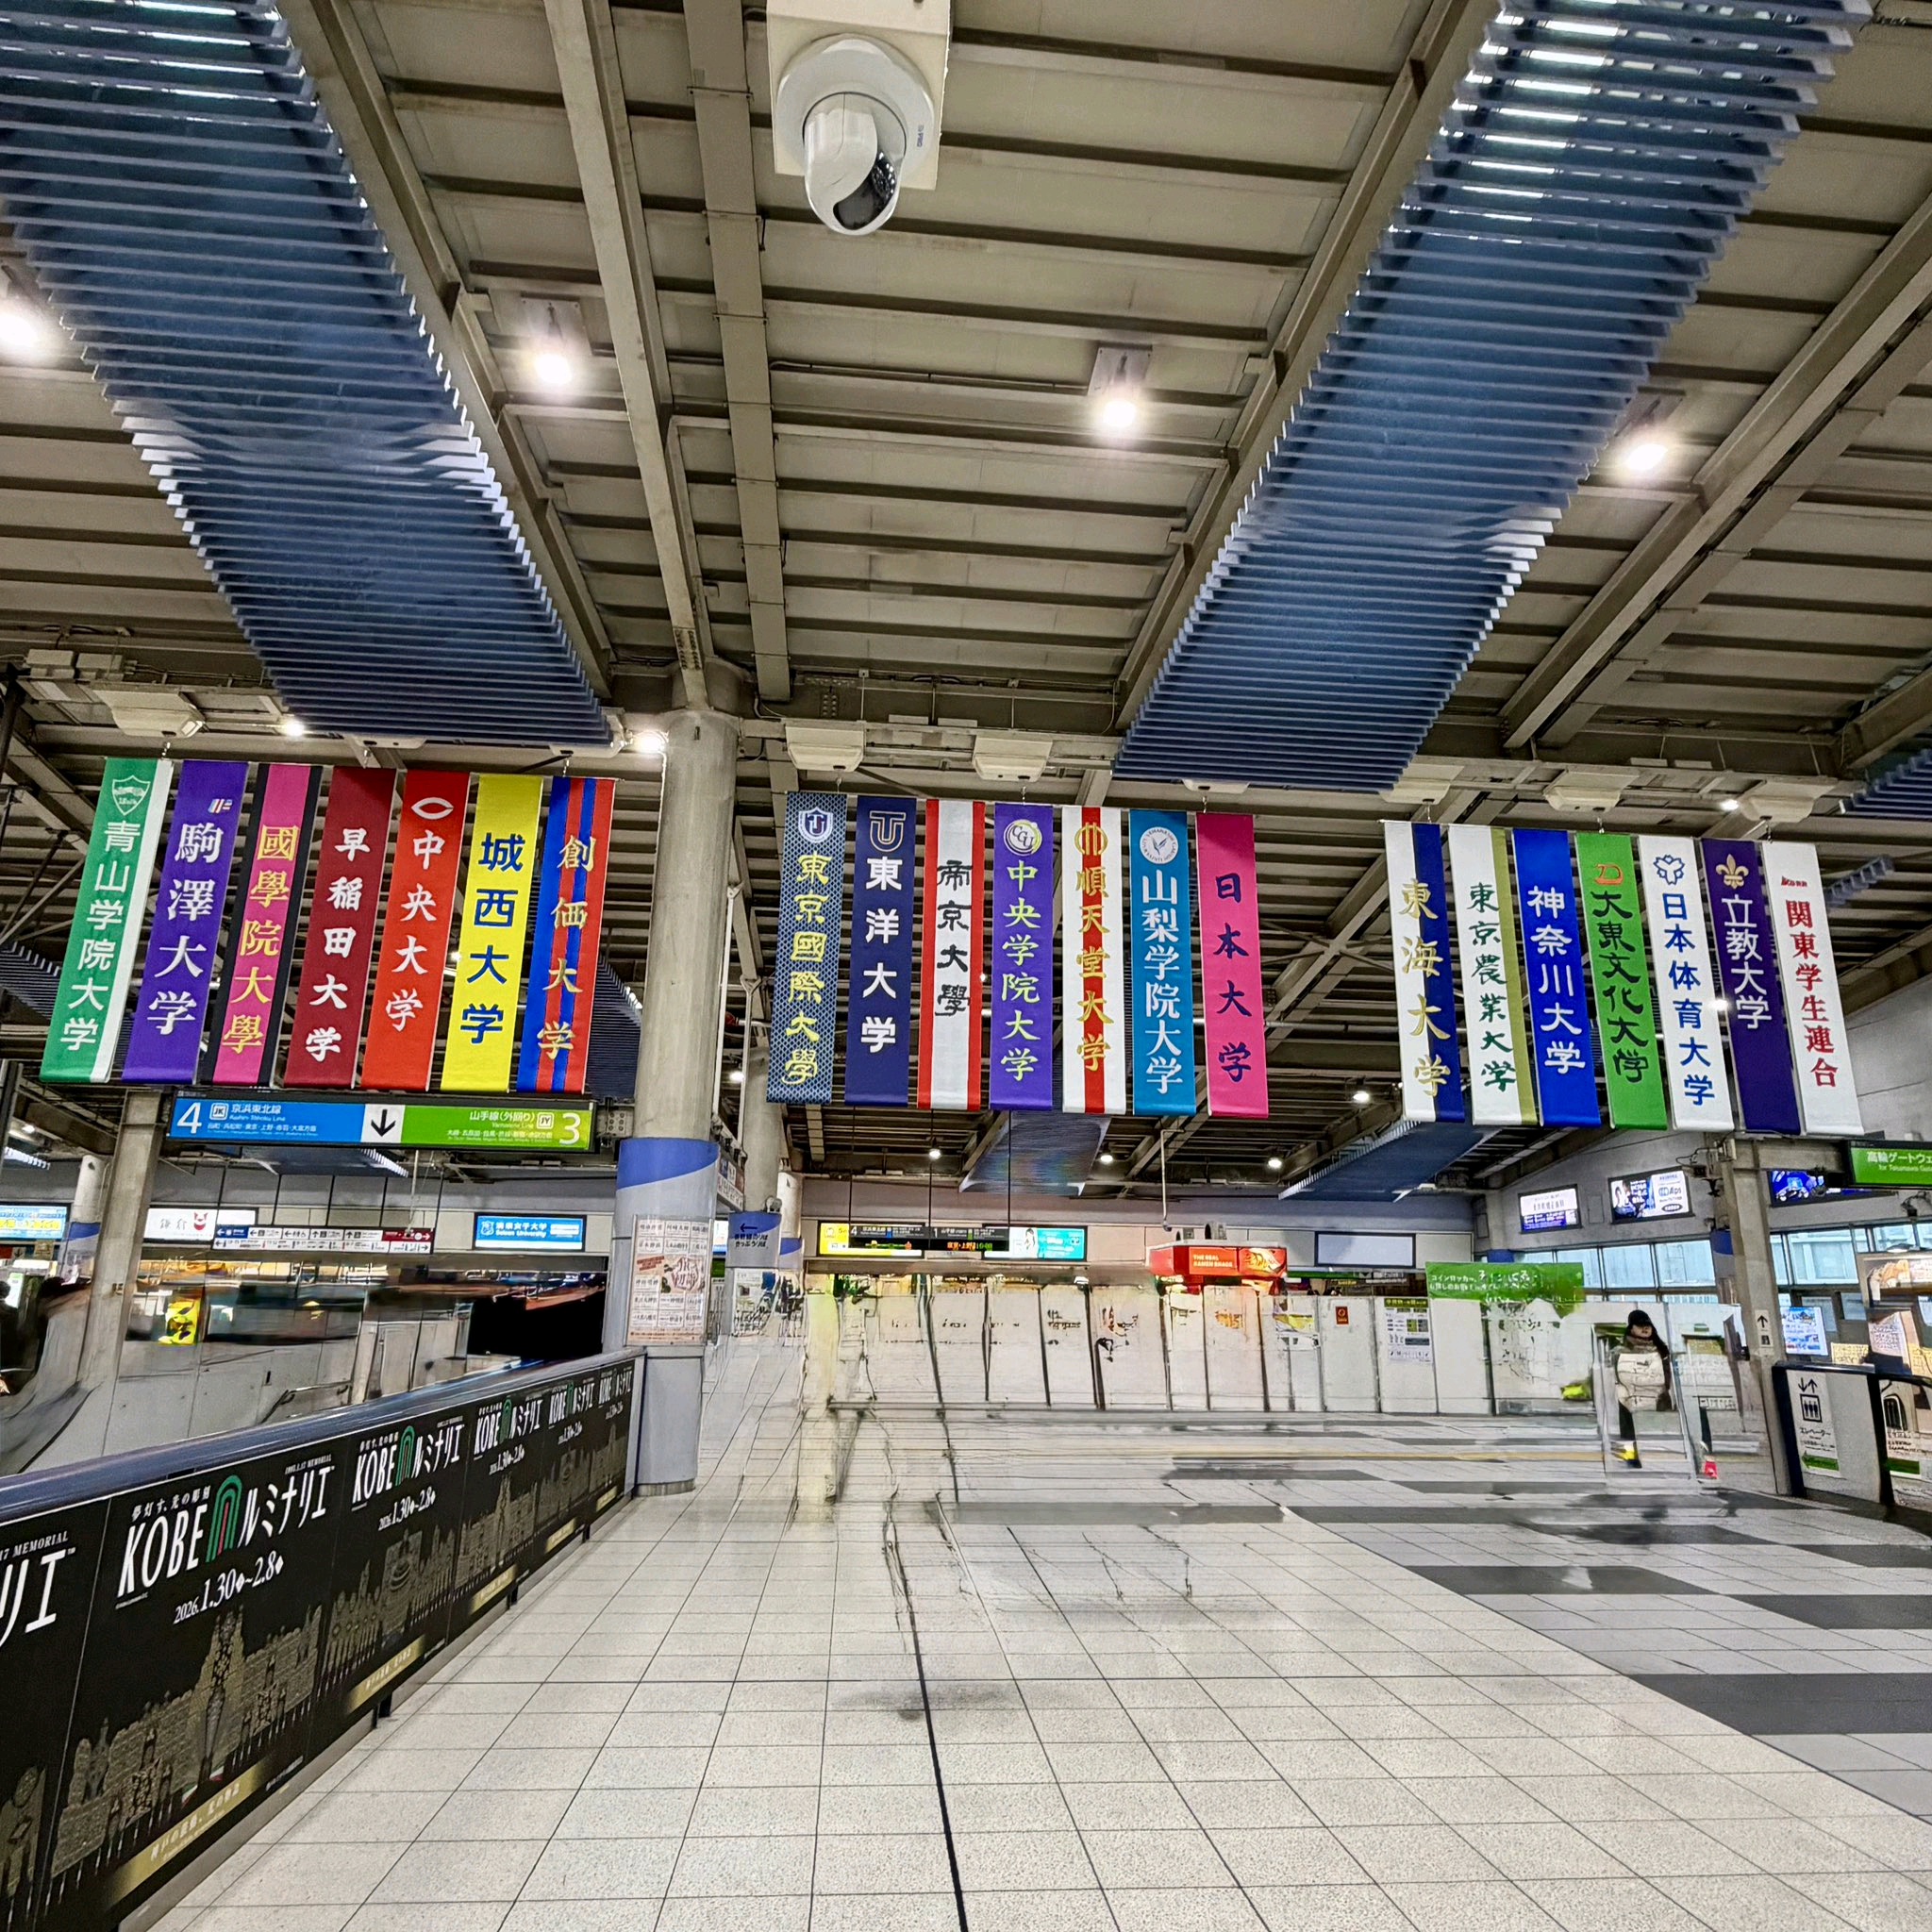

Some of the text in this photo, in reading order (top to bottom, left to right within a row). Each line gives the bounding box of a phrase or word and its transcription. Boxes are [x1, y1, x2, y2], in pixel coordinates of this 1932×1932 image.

[60, 820, 141, 1051] 青山学院大学
[148, 823, 223, 1034] 駒澤大学
[386, 830, 444, 1031] 中央大学
[1011, 824, 1036, 850] CGU
[224, 824, 299, 1053] 國學院大學
[306, 829, 371, 1061] 早稲田大学
[460, 833, 525, 1044] 城西大学
[537, 835, 594, 1060] 創価大学
[782, 851, 831, 1085] 東京國際大學
[860, 858, 903, 1053] 東洋大学
[934, 860, 973, 1017] 帝京大學
[1001, 860, 1041, 1081] 中央学院大学
[1075, 866, 1113, 1072] 順天堂大学
[1141, 870, 1183, 1094] 山梨学院大学
[1213, 873, 1253, 1082] 日本大学
[1399, 878, 1451, 1097] 東海大学
[1467, 882, 1517, 1091] 東京農業大学
[1527, 885, 1586, 1074] 神奈川大学
[1591, 891, 1649, 1083] 大東文化大学
[1663, 892, 1715, 1107] 日本体育大学
[1721, 894, 1773, 1030] 立教大学
[1786, 901, 1839, 1088] 関東学生連合
[176, 1103, 202, 1133] 4
[231, 1104, 281, 1115] 京浜東北線
[559, 1113, 581, 1144] 3
[117, 1466, 331, 1599] KOBE ルミナリエ
[352, 1425, 463, 1504] KOBE ルミナリエ
[474, 1411, 501, 1456] KOBE
[12, 1530, 69, 1557] MEMORIAL
